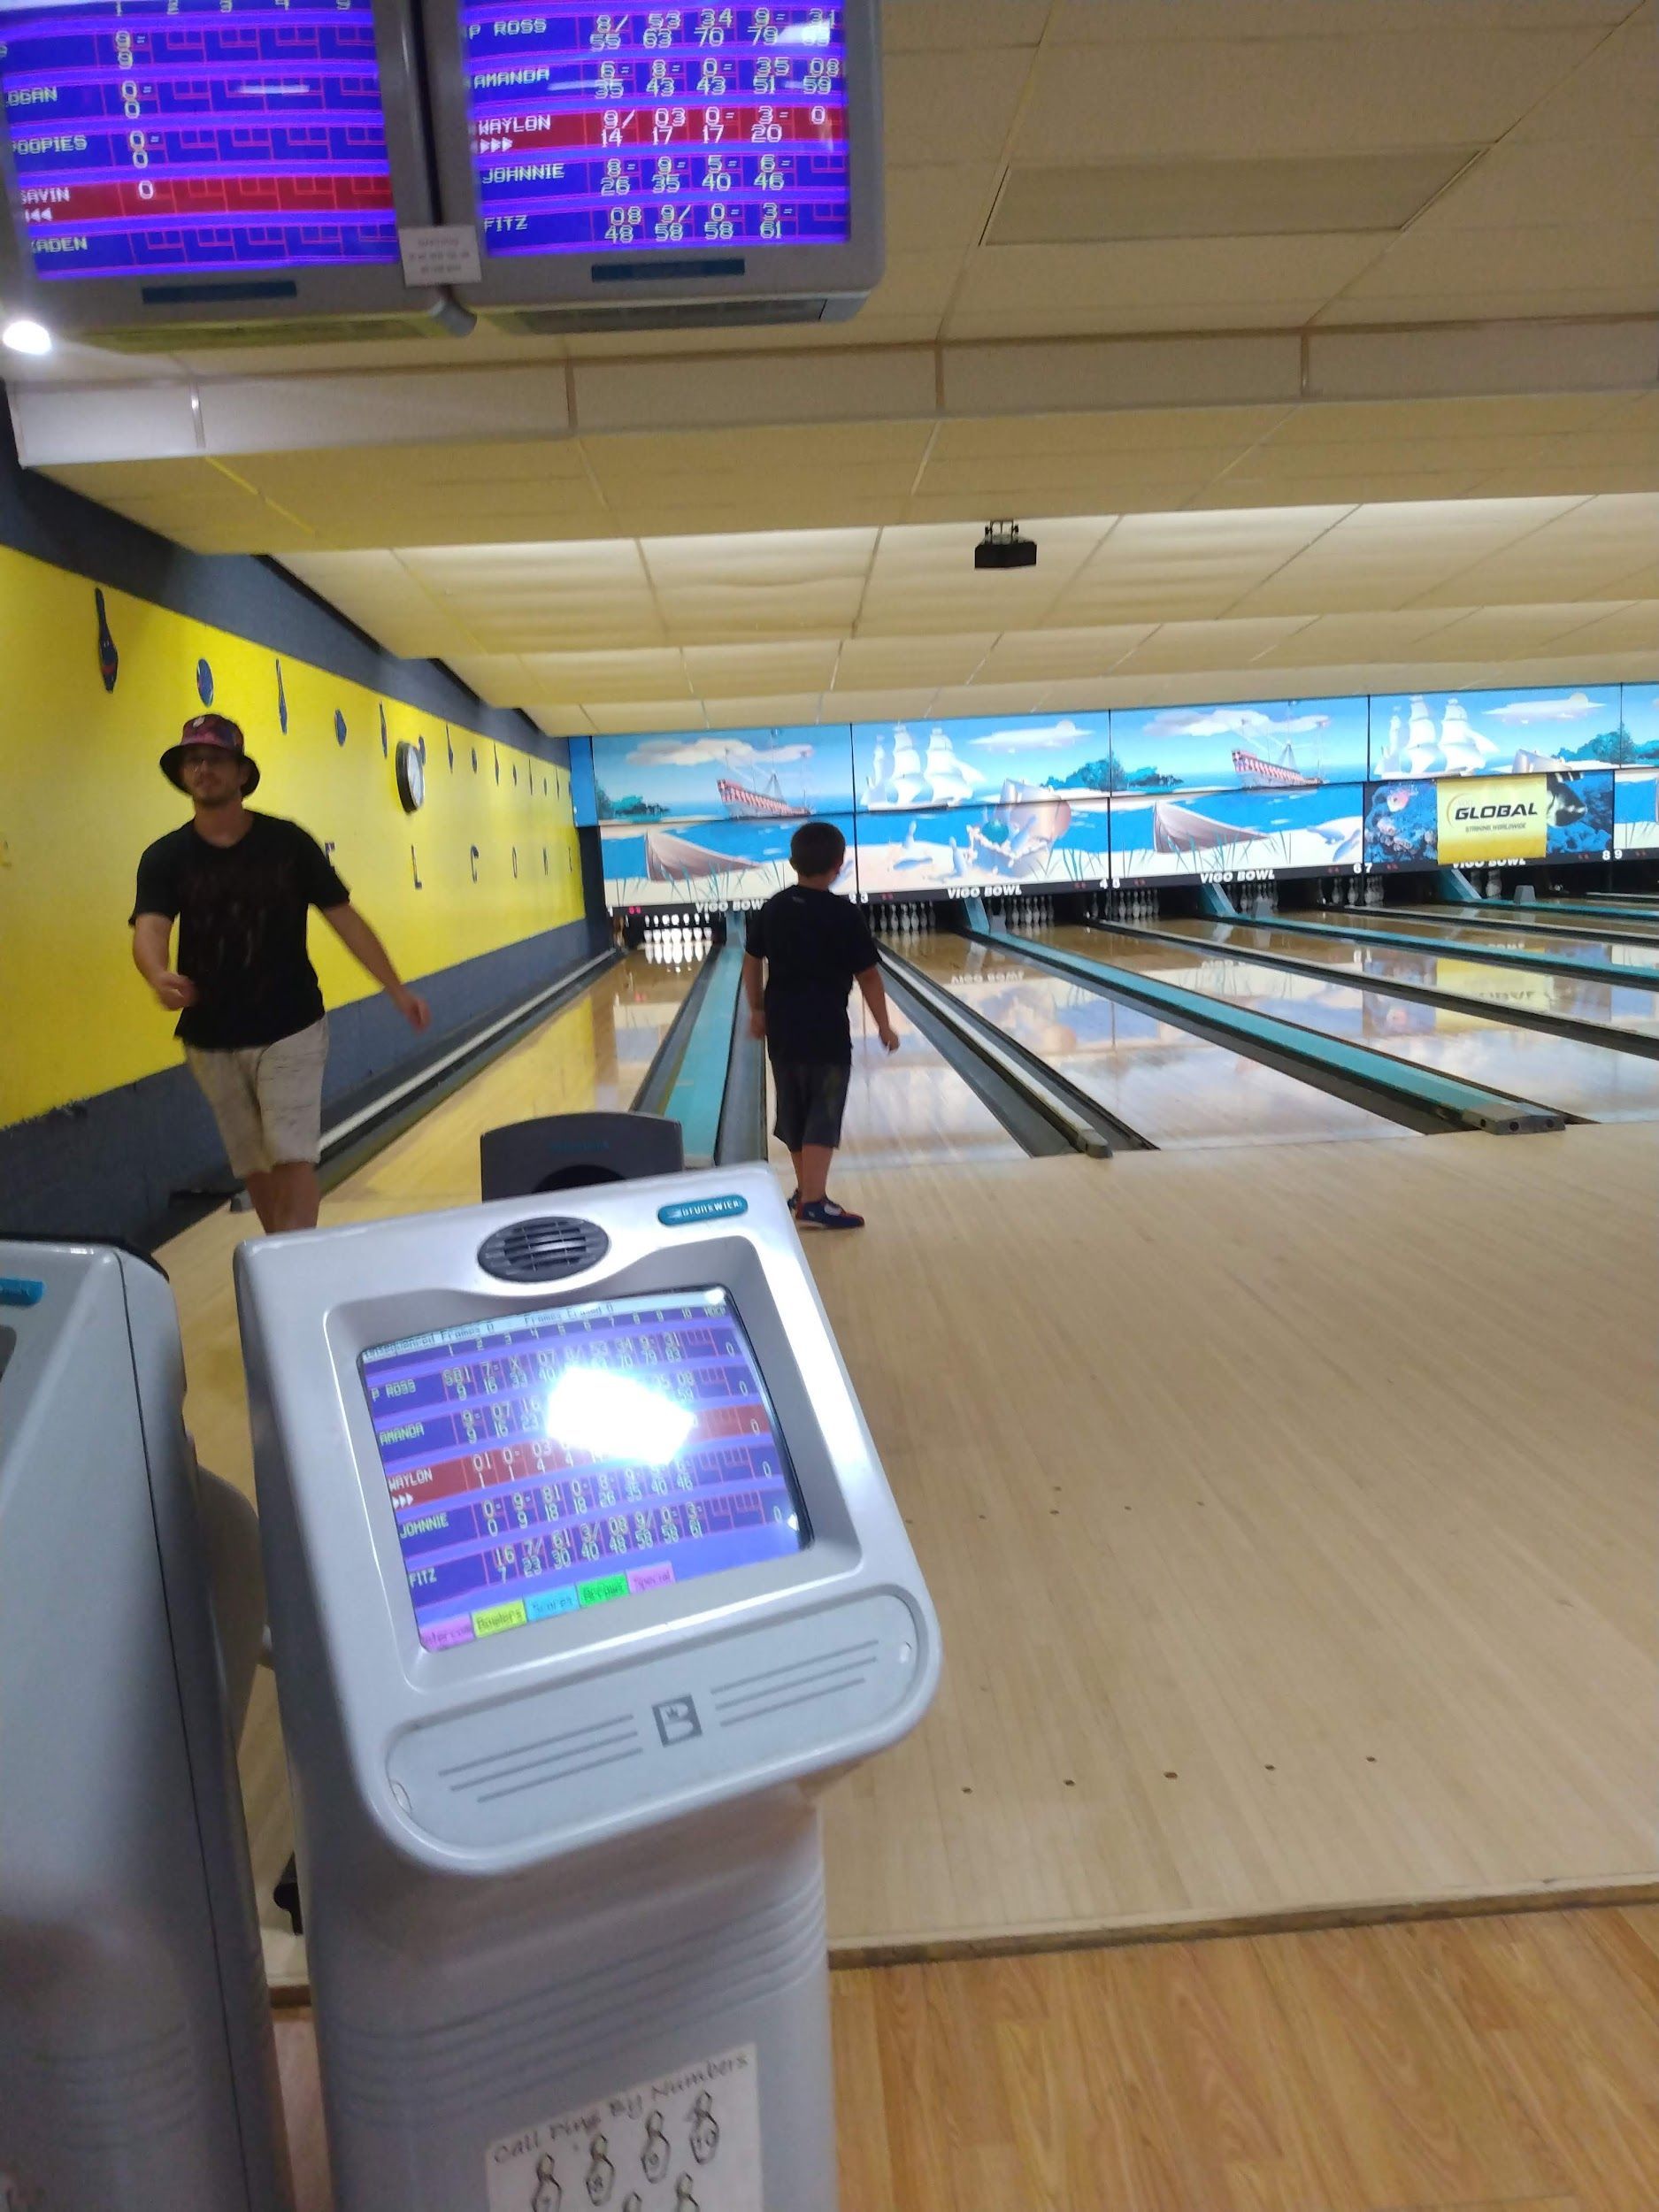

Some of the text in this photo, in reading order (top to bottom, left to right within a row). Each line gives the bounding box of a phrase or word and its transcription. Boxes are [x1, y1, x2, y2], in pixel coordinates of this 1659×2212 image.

[469, 19, 547, 40] P ROSS
[590, 25, 778, 51] 55 63 70 79
[757, 57, 789, 76] 35
[474, 65, 549, 89] AMANDA
[595, 80, 624, 99] 35
[646, 77, 674, 97] 43
[696, 75, 726, 95] 43
[753, 75, 775, 95] 51
[125, 100, 140, 119] 0
[655, 107, 686, 127] 03
[811, 106, 826, 125] 0
[479, 114, 551, 135] WAYLON
[602, 124, 782, 148] 14 17 17 20
[134, 150, 149, 169] 0
[482, 163, 565, 184] JOHNNIE
[139, 180, 154, 199] 0
[601, 172, 784, 196] 26 35 40 46
[484, 215, 528, 233] FITZ
[611, 206, 641, 225] 08
[604, 220, 781, 243] 48 58 58 61
[1455, 803, 1538, 820] GLOBAL
[1602, 850, 1610, 860] 8
[1615, 849, 1623, 859] 9
[1200, 870, 1275, 883] VIGO BOWL
[1354, 864, 1361, 873] 6
[1365, 863, 1372, 872] 7
[948, 885, 1022, 899] VIGO BOWL
[695, 898, 764, 913] VIGO BOW
[531, 1327, 539, 1340] 4
[726, 1341, 734, 1357] 0
[372, 1387, 380, 1402] P
[739, 1380, 749, 1396] 0
[380, 1422, 425, 1446] AMANDA
[750, 1418, 760, 1435] 0
[388, 1467, 434, 1492] WAYLON
[763, 1461, 772, 1479] 0
[773, 1505, 782, 1523] 0
[400, 1511, 449, 1539] JOHNNIE
[488, 1518, 498, 1537] 0
[518, 1511, 528, 1529] 9
[409, 1566, 438, 1588] FITZ
[494, 2131, 539, 2163] Call
